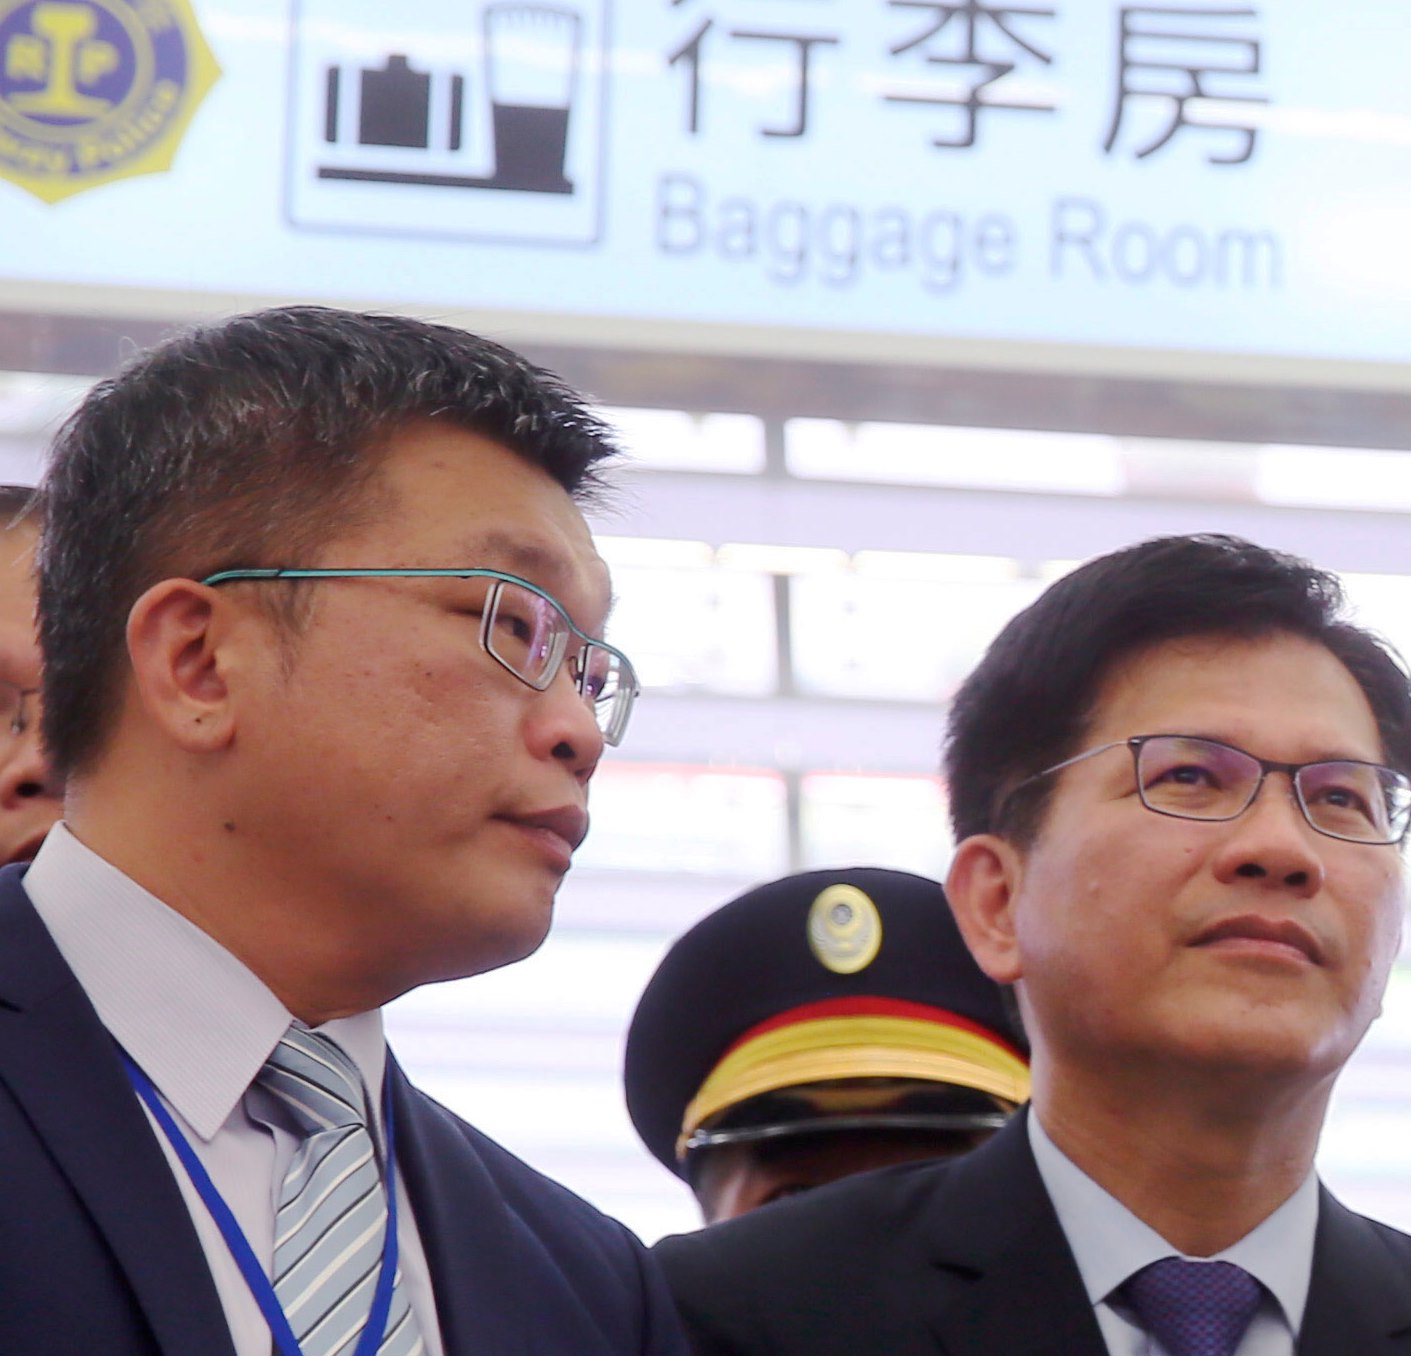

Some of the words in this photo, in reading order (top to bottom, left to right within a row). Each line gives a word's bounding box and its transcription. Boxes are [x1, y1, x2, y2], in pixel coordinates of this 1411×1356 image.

[668, 0, 1271, 165] 行李房
[655, 173, 1021, 294] Baggage
[1048, 194, 1284, 290] Room
